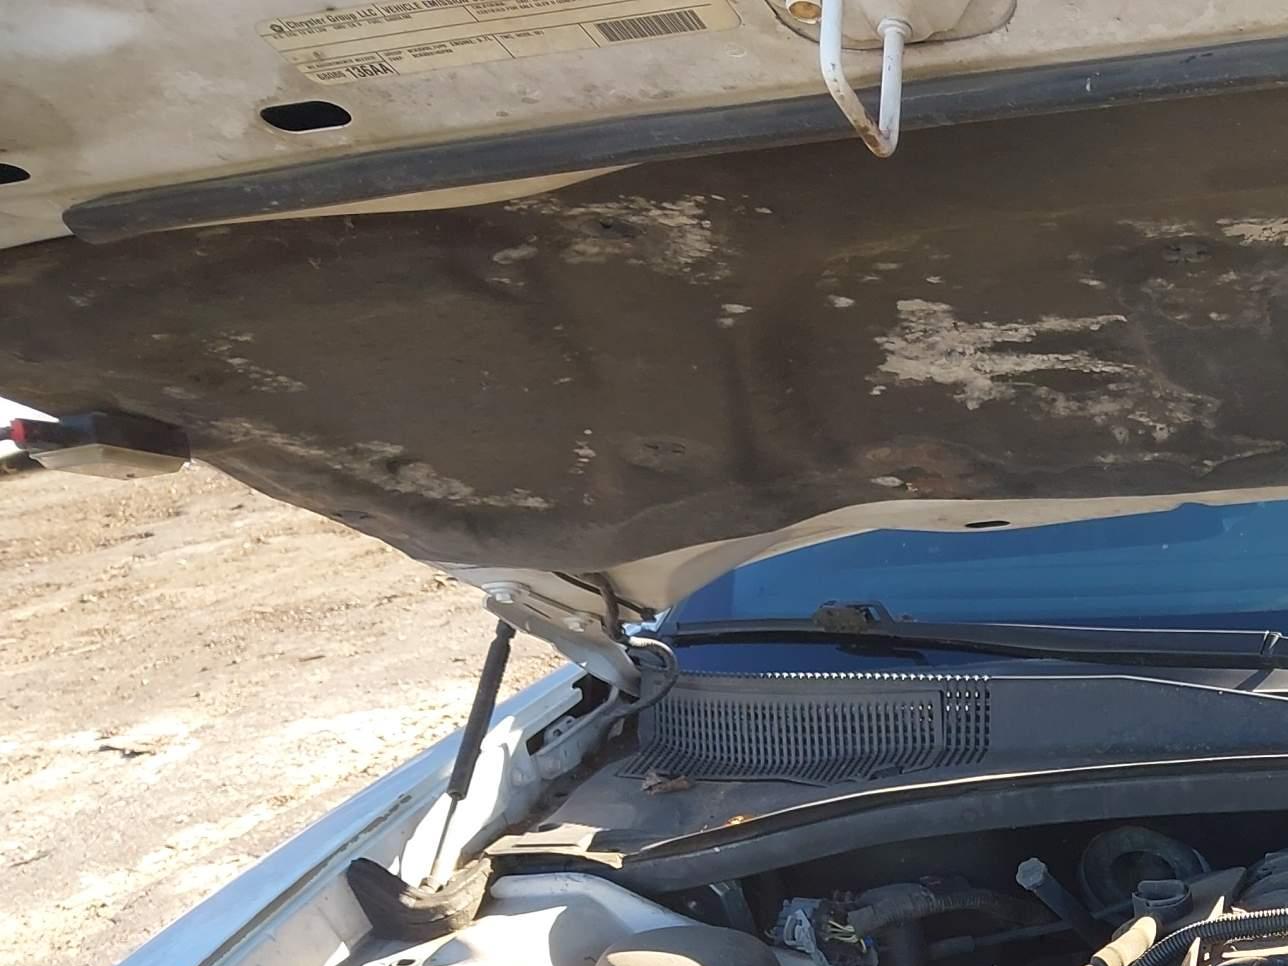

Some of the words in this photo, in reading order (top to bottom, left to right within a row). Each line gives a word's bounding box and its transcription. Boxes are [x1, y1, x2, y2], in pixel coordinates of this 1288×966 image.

[381, 2, 422, 14] VEHICLE
[284, 18, 326, 30] Chrysler
[326, 13, 357, 24] Group
[356, 8, 377, 18] LLC
[345, 63, 394, 79] 136AA
